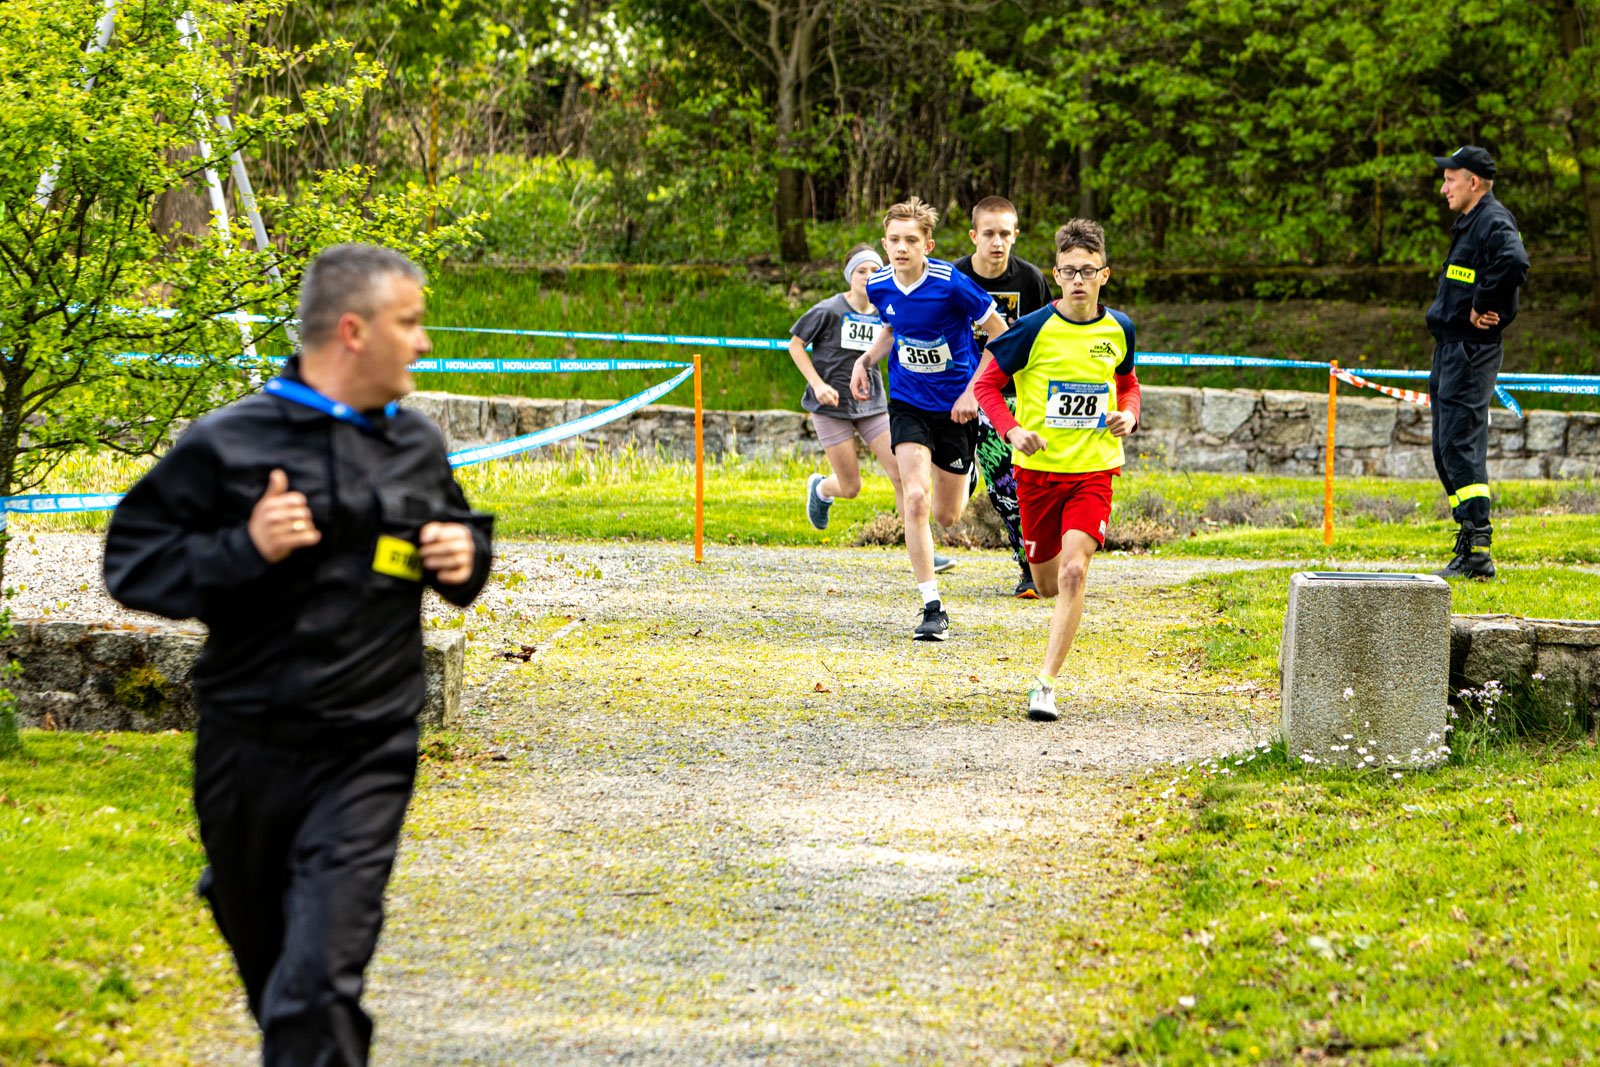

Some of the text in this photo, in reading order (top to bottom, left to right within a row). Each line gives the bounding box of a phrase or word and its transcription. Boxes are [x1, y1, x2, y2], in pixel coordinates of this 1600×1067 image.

[848, 322, 874, 342] 344
[906, 346, 941, 365] 356
[1058, 394, 1098, 416] 328
[1025, 540, 1037, 558] 7
